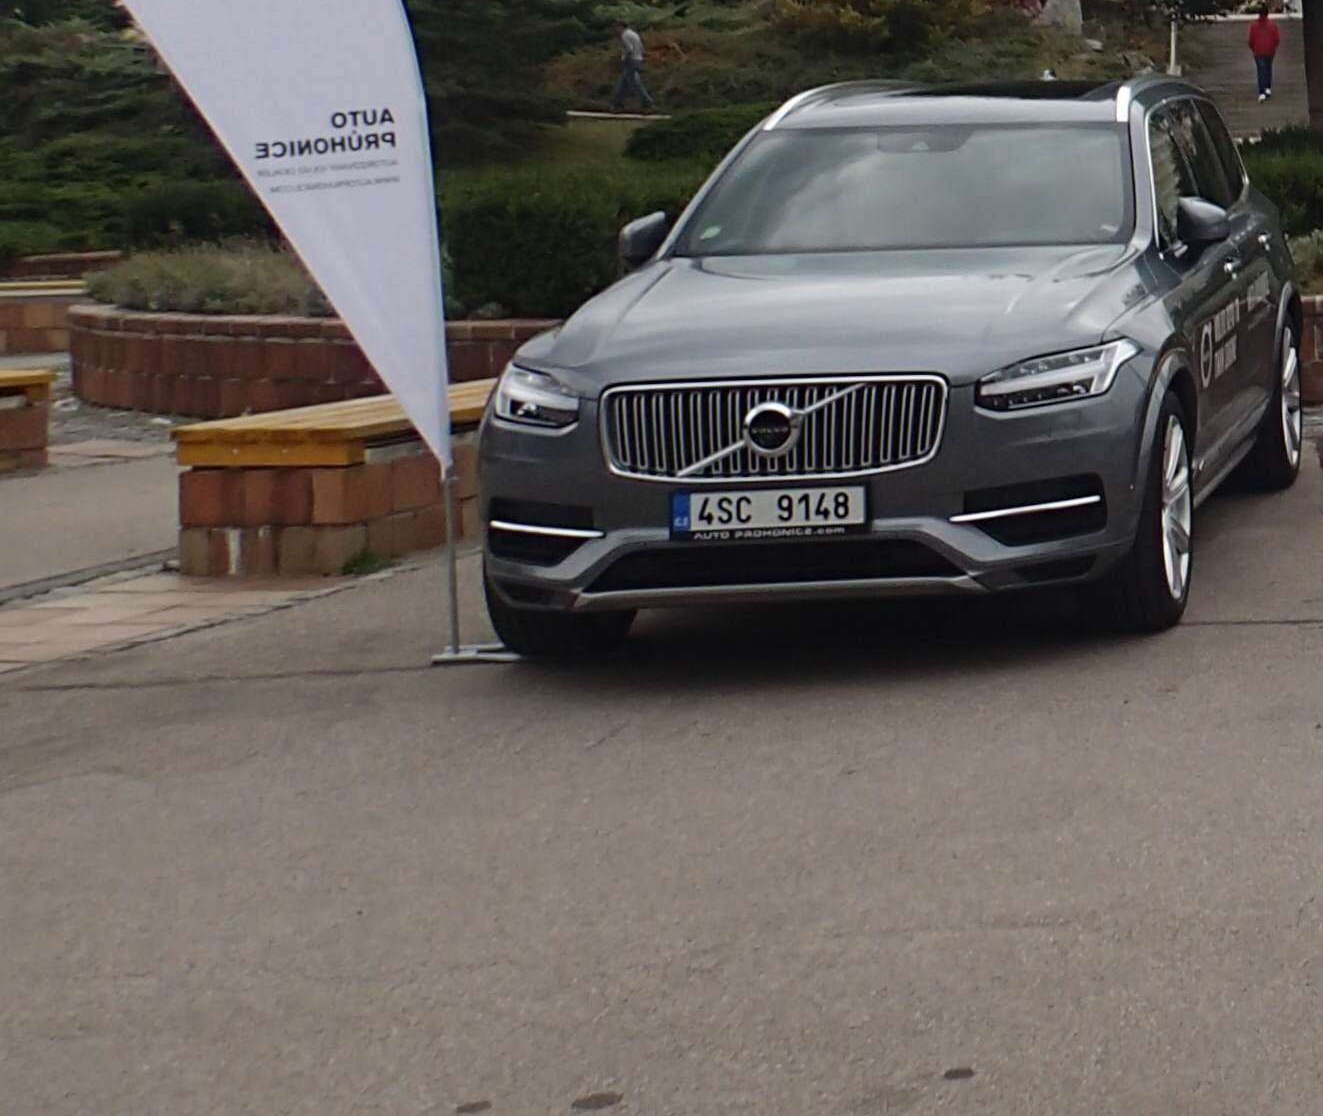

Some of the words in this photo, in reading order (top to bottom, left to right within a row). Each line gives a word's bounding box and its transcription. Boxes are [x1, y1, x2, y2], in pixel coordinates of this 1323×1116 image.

[698, 496, 752, 525] 4SC
[776, 492, 849, 522] 9148
[694, 529, 730, 540] AUTO
